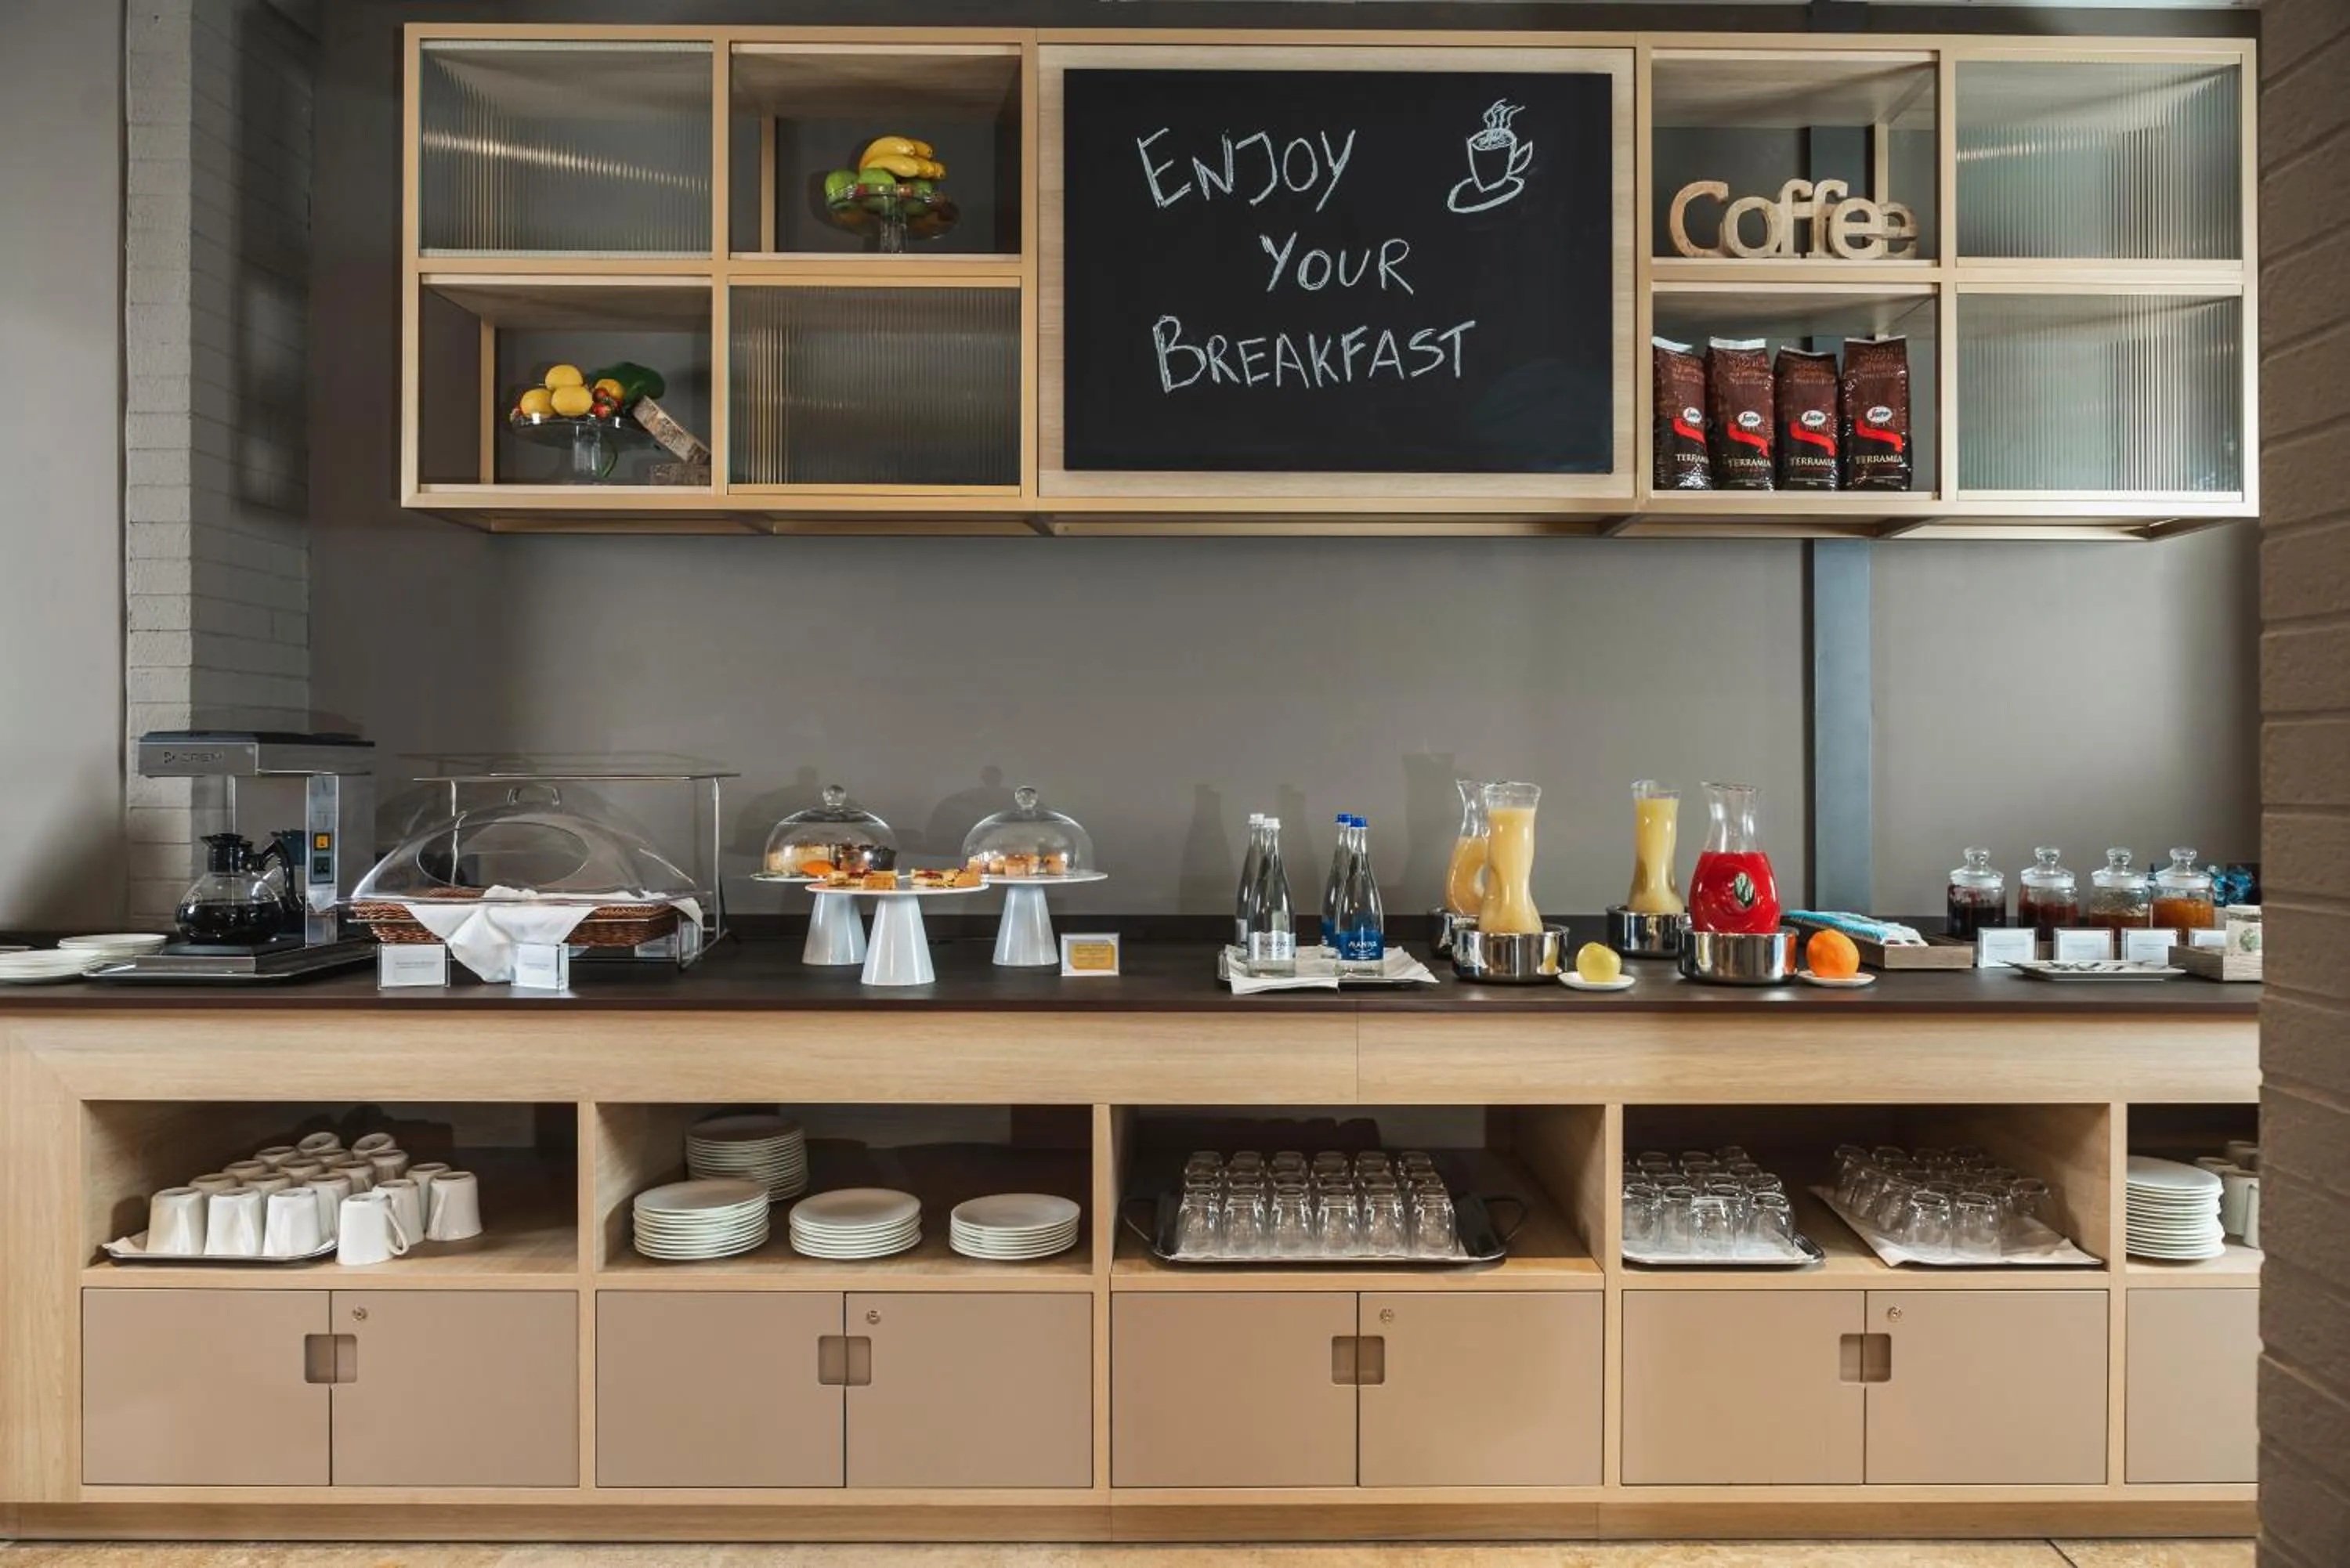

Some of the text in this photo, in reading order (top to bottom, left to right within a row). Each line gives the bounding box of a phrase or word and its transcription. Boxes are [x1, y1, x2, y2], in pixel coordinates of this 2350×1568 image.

[1137, 128, 1355, 211] ENJOY
[1670, 179, 1918, 259] Coffee
[1260, 232, 1413, 294] YOUR
[1153, 315, 1475, 392] BREAKFAST
[1728, 457, 1771, 468] TERRAMIA
[1790, 456, 1835, 467] TERRAMIA
[1855, 454, 1903, 465] TERRAMIA
